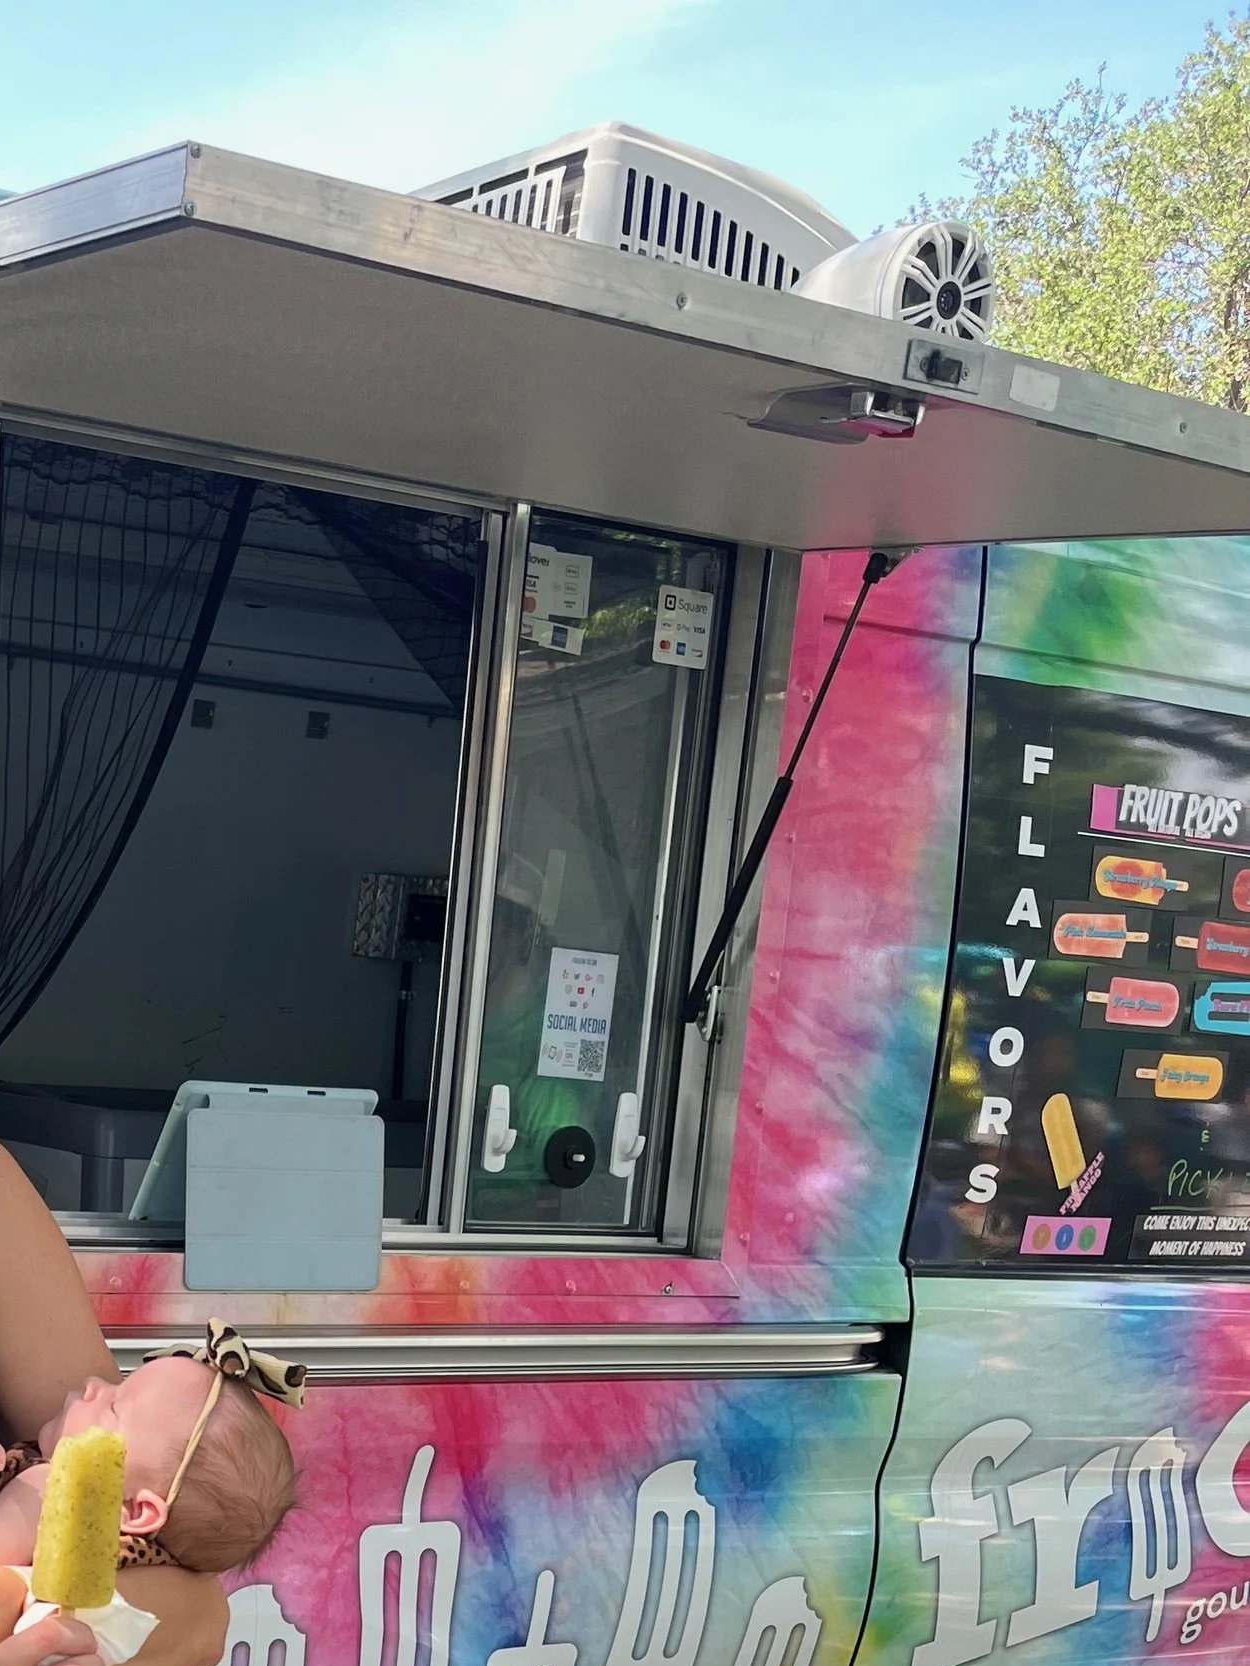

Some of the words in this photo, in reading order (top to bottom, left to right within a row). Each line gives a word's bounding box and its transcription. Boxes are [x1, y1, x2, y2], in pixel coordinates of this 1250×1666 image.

[678, 599, 708, 614] Square
[1118, 784, 1184, 828] FRUIT
[1182, 793, 1242, 837] POPS
[965, 744, 1054, 1204] FLAVORS
[547, 1013, 577, 1032] SOCIAL
[579, 1017, 607, 1035] MEDIA
[1143, 1215, 1170, 1230] COME
[1169, 1215, 1197, 1230] ENJOY
[1196, 1216, 1217, 1230] THIS
[1149, 1240, 1189, 1256] MOMENT
[1187, 1241, 1203, 1256] OF
[1200, 1241, 1246, 1256] HAPPINESS
[1180, 1581, 1250, 1644] gou
